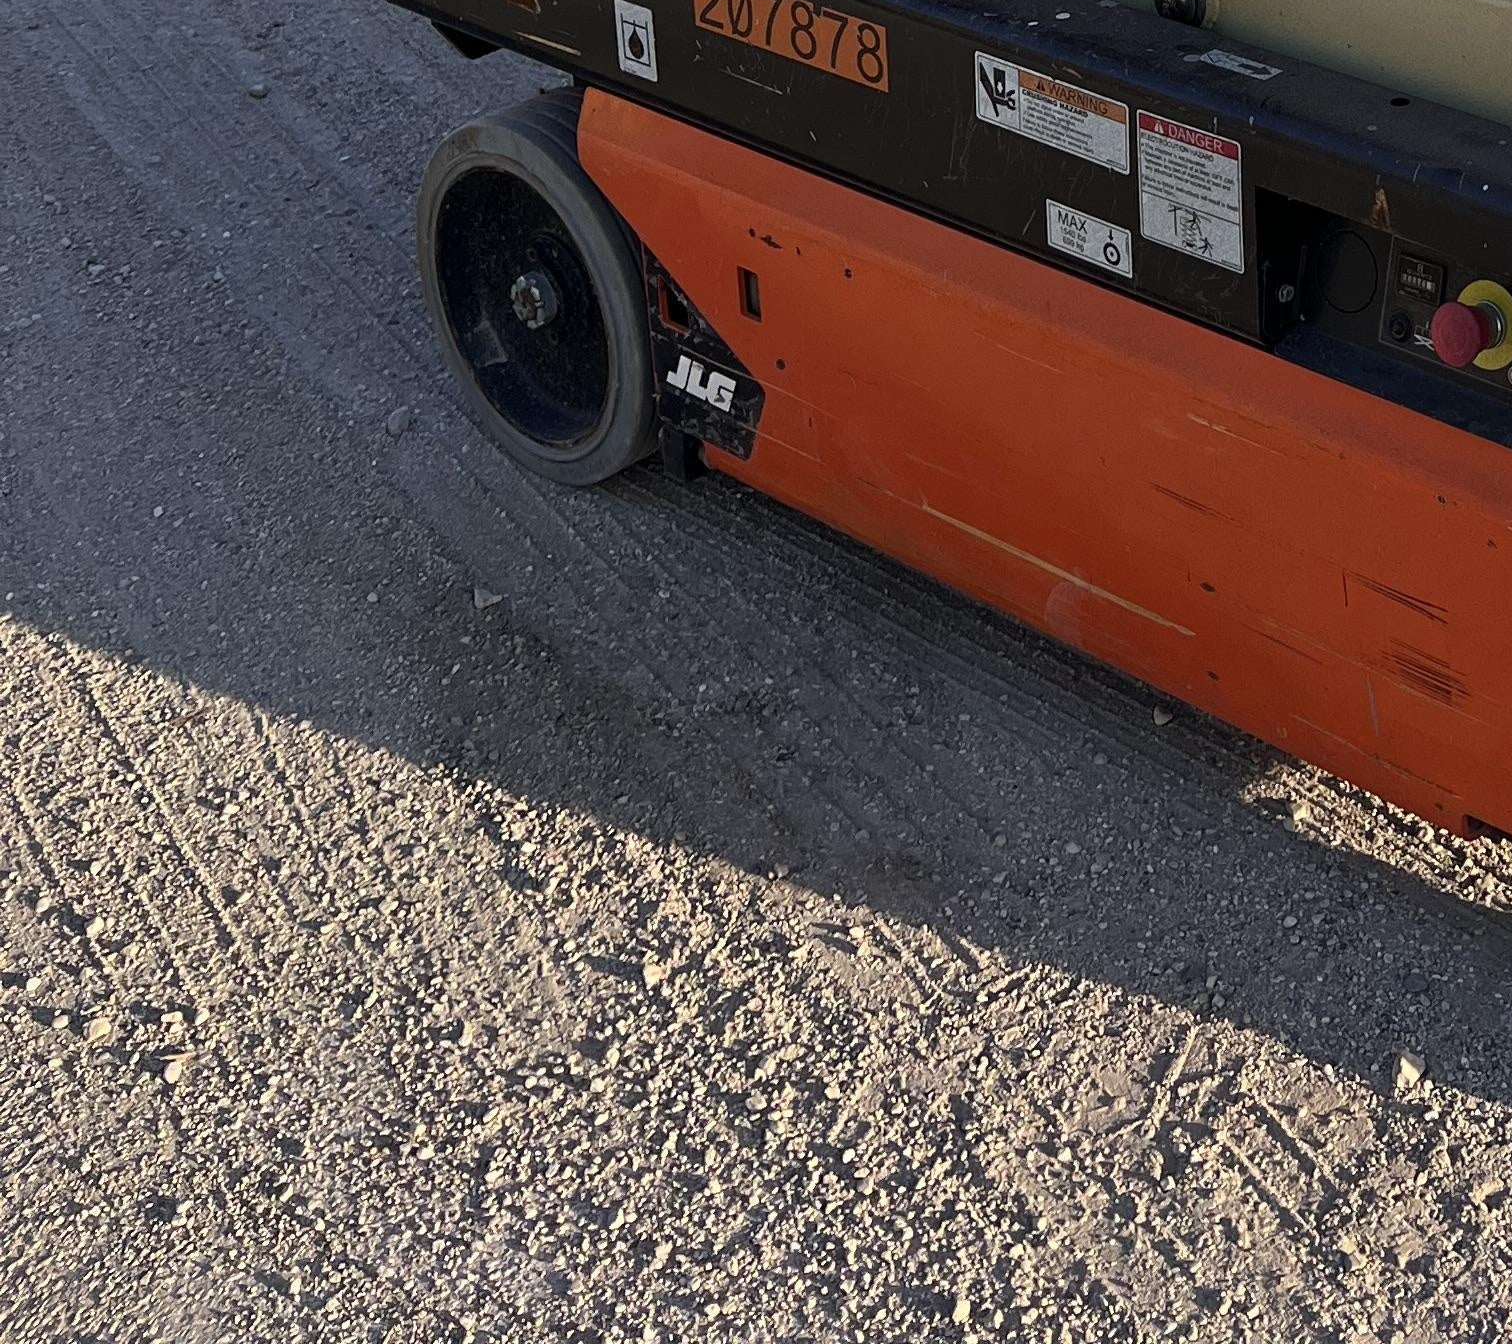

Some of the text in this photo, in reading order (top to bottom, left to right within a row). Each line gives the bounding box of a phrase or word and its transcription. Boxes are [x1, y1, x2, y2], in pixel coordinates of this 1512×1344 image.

[1048, 81, 1108, 114] WARNING
[1168, 124, 1223, 153] DANGER
[1057, 209, 1088, 234] MAX
[666, 355, 736, 412] JLG
